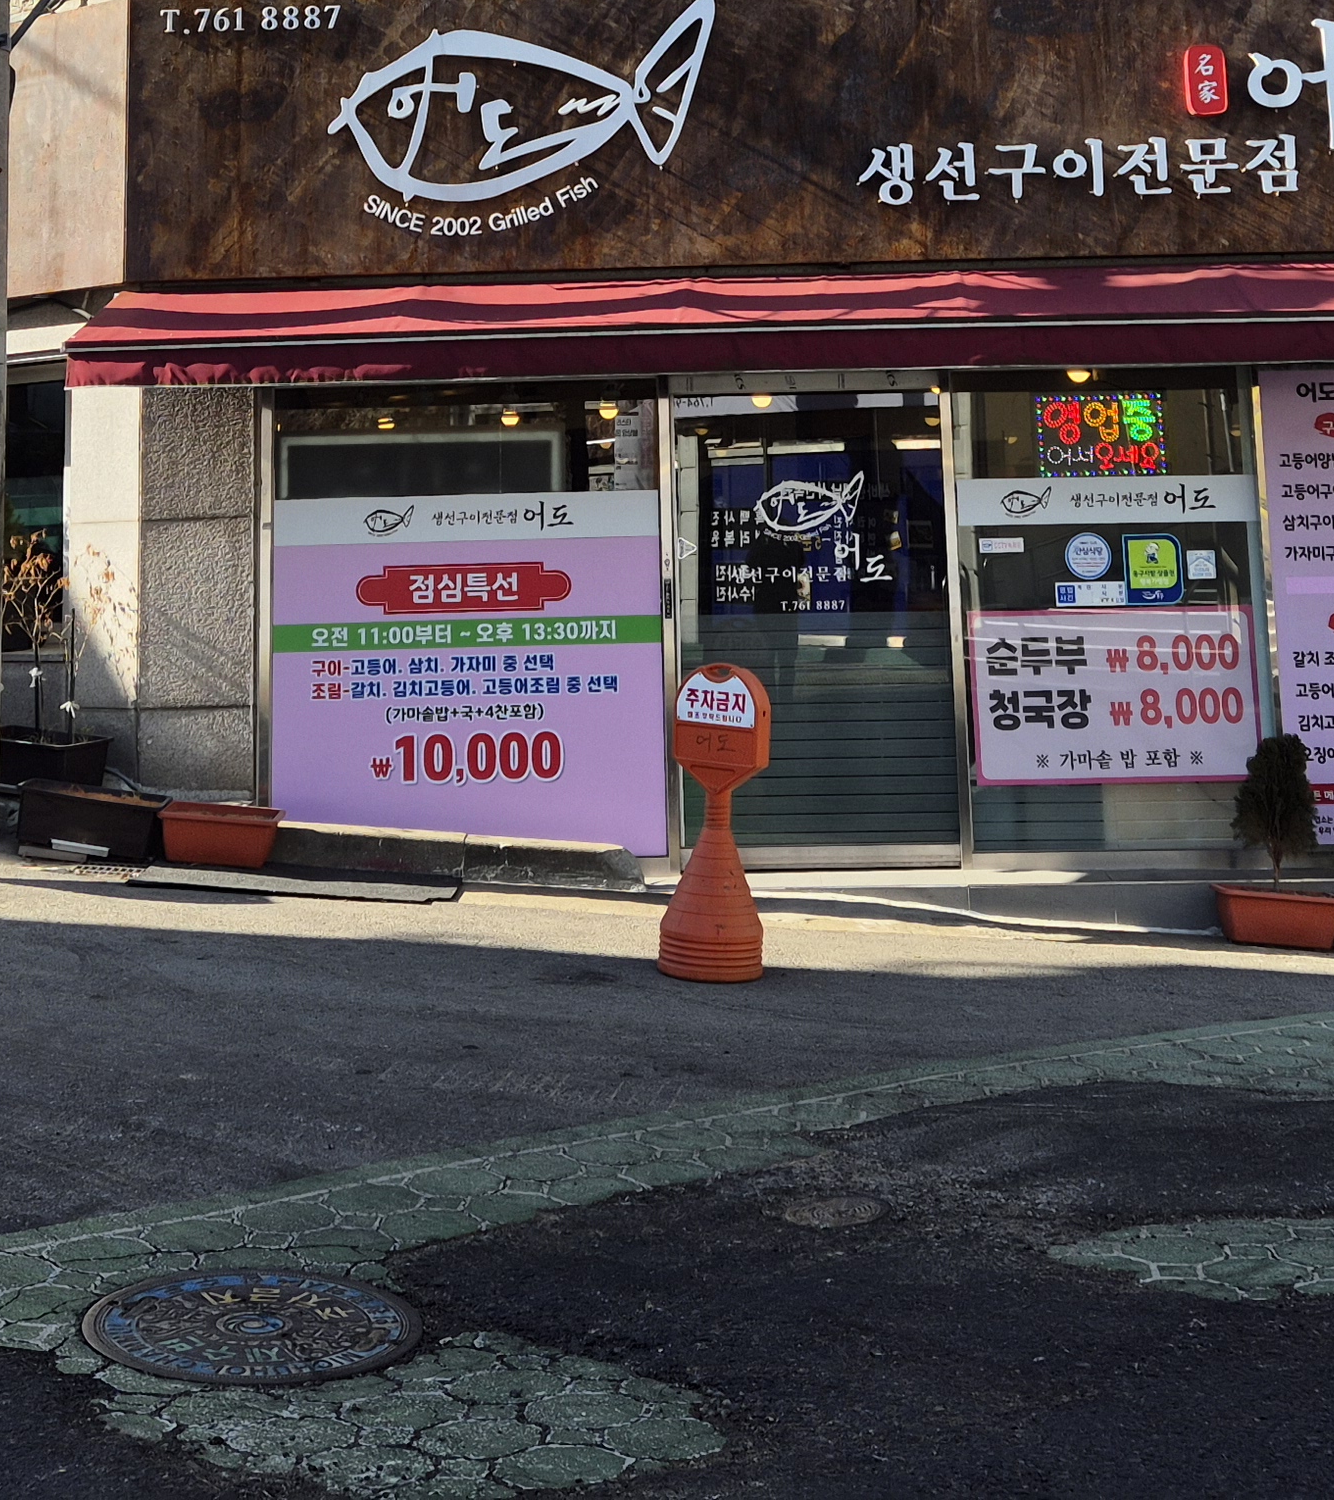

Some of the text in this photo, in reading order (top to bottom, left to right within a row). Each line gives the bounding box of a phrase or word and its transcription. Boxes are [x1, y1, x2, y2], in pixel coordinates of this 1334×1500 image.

[160, 4, 342, 35] T.761 8887
[1194, 52, 1220, 106] 名家
[856, 133, 1300, 206] 생선구이전문점
[363, 175, 600, 236] SINCE 2002 Grilled Fish
[1043, 400, 1156, 445] 영업중
[1070, 483, 1217, 514] 생선구이전문점 어도
[432, 501, 574, 531] 생선구이전문점 어도
[834, 533, 893, 583] 어도
[408, 572, 520, 604] 점심특선
[780, 600, 845, 612] T.761 8887
[311, 627, 349, 648] 오전
[357, 624, 453, 647] 11:00부터
[476, 622, 514, 644] 오후
[522, 619, 618, 642] 13:30까지
[450, 655, 497, 673] 가자미
[503, 655, 518, 672] 중
[524, 654, 555, 672] 선택
[985, 636, 1088, 676] 순두부
[1292, 651, 1320, 668] 갈치
[482, 677, 560, 695] 고등어조림
[566, 676, 582, 694] 중
[587, 675, 619, 694] 선택
[1295, 683, 1334, 700] 고등어
[686, 688, 746, 714] 주차금지
[989, 689, 1092, 731] 청국장
[696, 731, 736, 752] 어도
[1060, 748, 1181, 771] 가마솥 밥 포함
